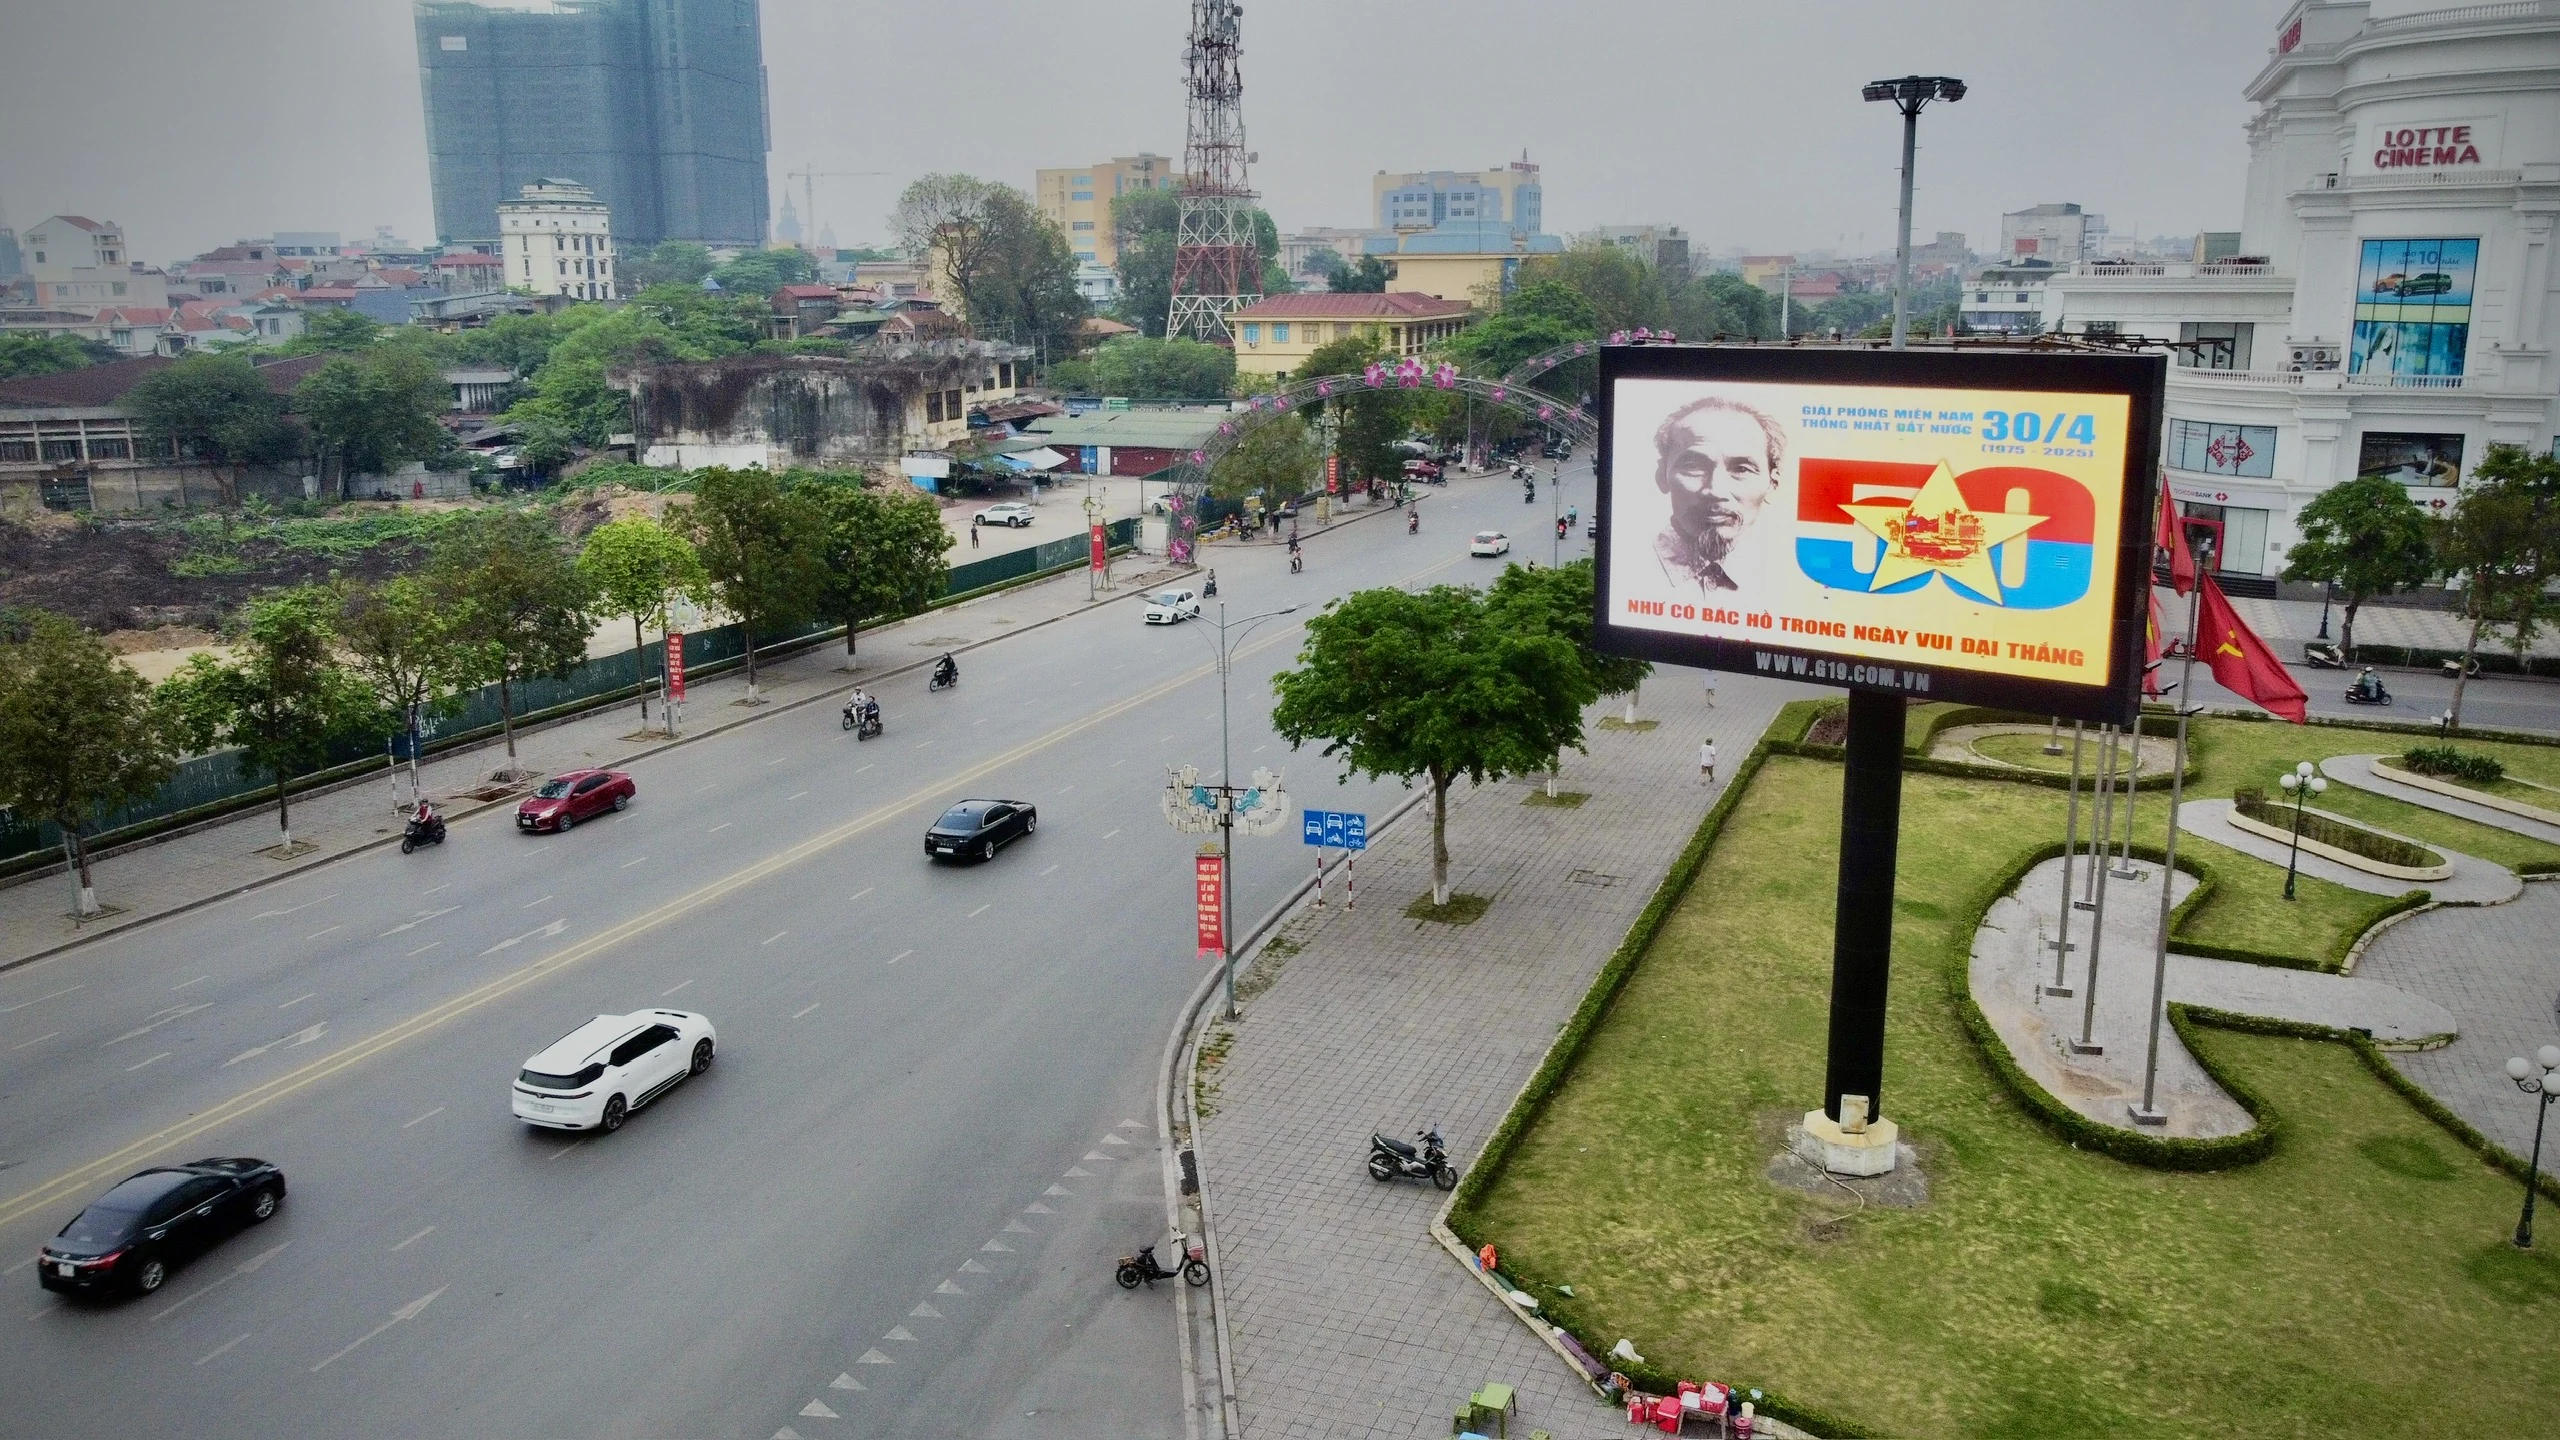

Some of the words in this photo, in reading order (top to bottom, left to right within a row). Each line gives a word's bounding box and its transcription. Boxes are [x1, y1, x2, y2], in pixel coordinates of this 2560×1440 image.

[2384, 125, 2471, 148] LOTTE
[2374, 144, 2480, 169] CINEMA
[2419, 250, 2438, 265] 10
[1801, 405, 1832, 416] GIẢI
[1837, 406, 1888, 418] PHÓNG
[1894, 408, 1932, 420] MIỀN
[1938, 411, 1973, 422] NAM
[1801, 417, 1848, 429] THỐNG
[1853, 418, 1890, 431] NHẤT
[1896, 420, 1924, 433] ĐẤT
[1930, 422, 1972, 435] NƯỚC
[1981, 410, 2096, 445] 30/4
[1981, 444, 2025, 455] (1975
[2043, 447, 2094, 458] 2025)
[1795, 458, 2096, 610] 50
[1627, 599, 1666, 616] NHƯ
[1671, 603, 1695, 620] CÓ
[1702, 606, 1740, 625] BÁC
[1746, 609, 1773, 629] HỒ
[1779, 616, 1846, 639] TRONG
[1853, 624, 1909, 645] NGÀY
[1916, 631, 1953, 651] VUI
[1960, 637, 1999, 658] ĐẠI
[2007, 641, 2084, 667] THẮNG
[1755, 651, 1930, 692] WWW.G19.COM.VN
